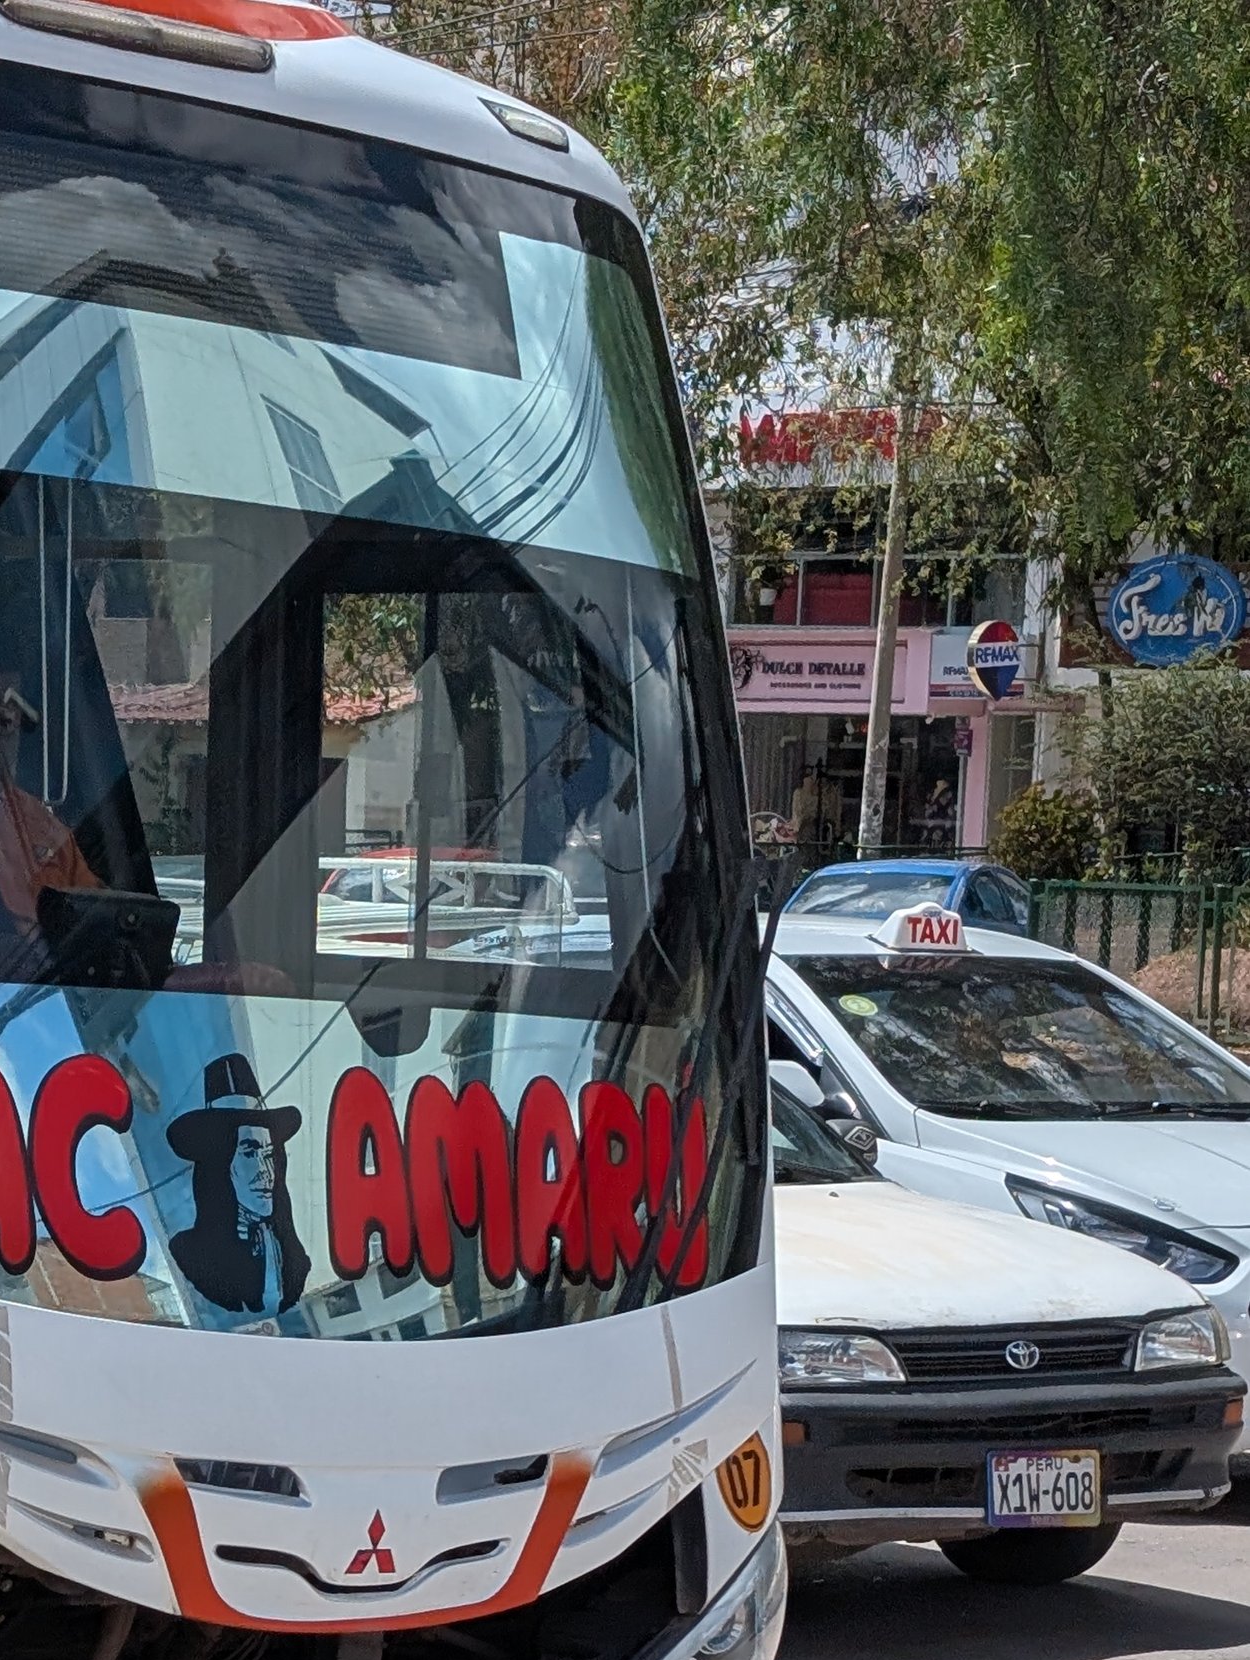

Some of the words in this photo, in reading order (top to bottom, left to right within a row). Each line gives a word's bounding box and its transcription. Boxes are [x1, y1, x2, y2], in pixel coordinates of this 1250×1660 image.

[762, 661, 803, 675] DULCE
[808, 662, 866, 676] DETALLE
[907, 917, 959, 945] TAXI
[1026, 1458, 1064, 1473] PERU
[997, 1471, 1094, 1514] X1W-608
